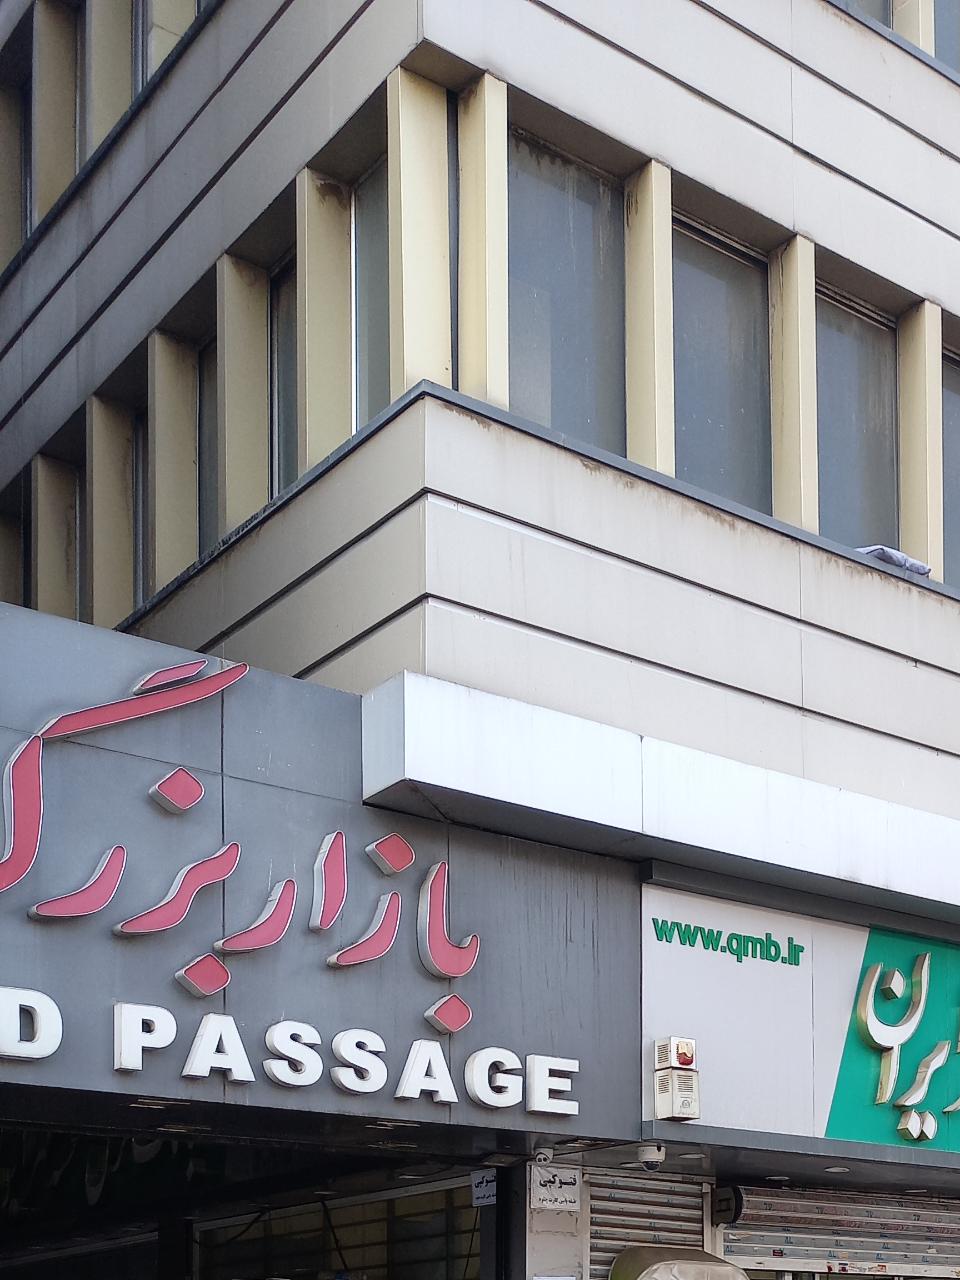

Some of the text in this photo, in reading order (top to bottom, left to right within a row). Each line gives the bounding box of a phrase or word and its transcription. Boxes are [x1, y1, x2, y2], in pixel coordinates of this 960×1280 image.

[213, 830, 481, 1035] بازار
[651, 917, 805, 966] www.qmb.ir
[112, 1001, 580, 1117] PASSAGE
[539, 1174, 577, 1189] فتوکپی
